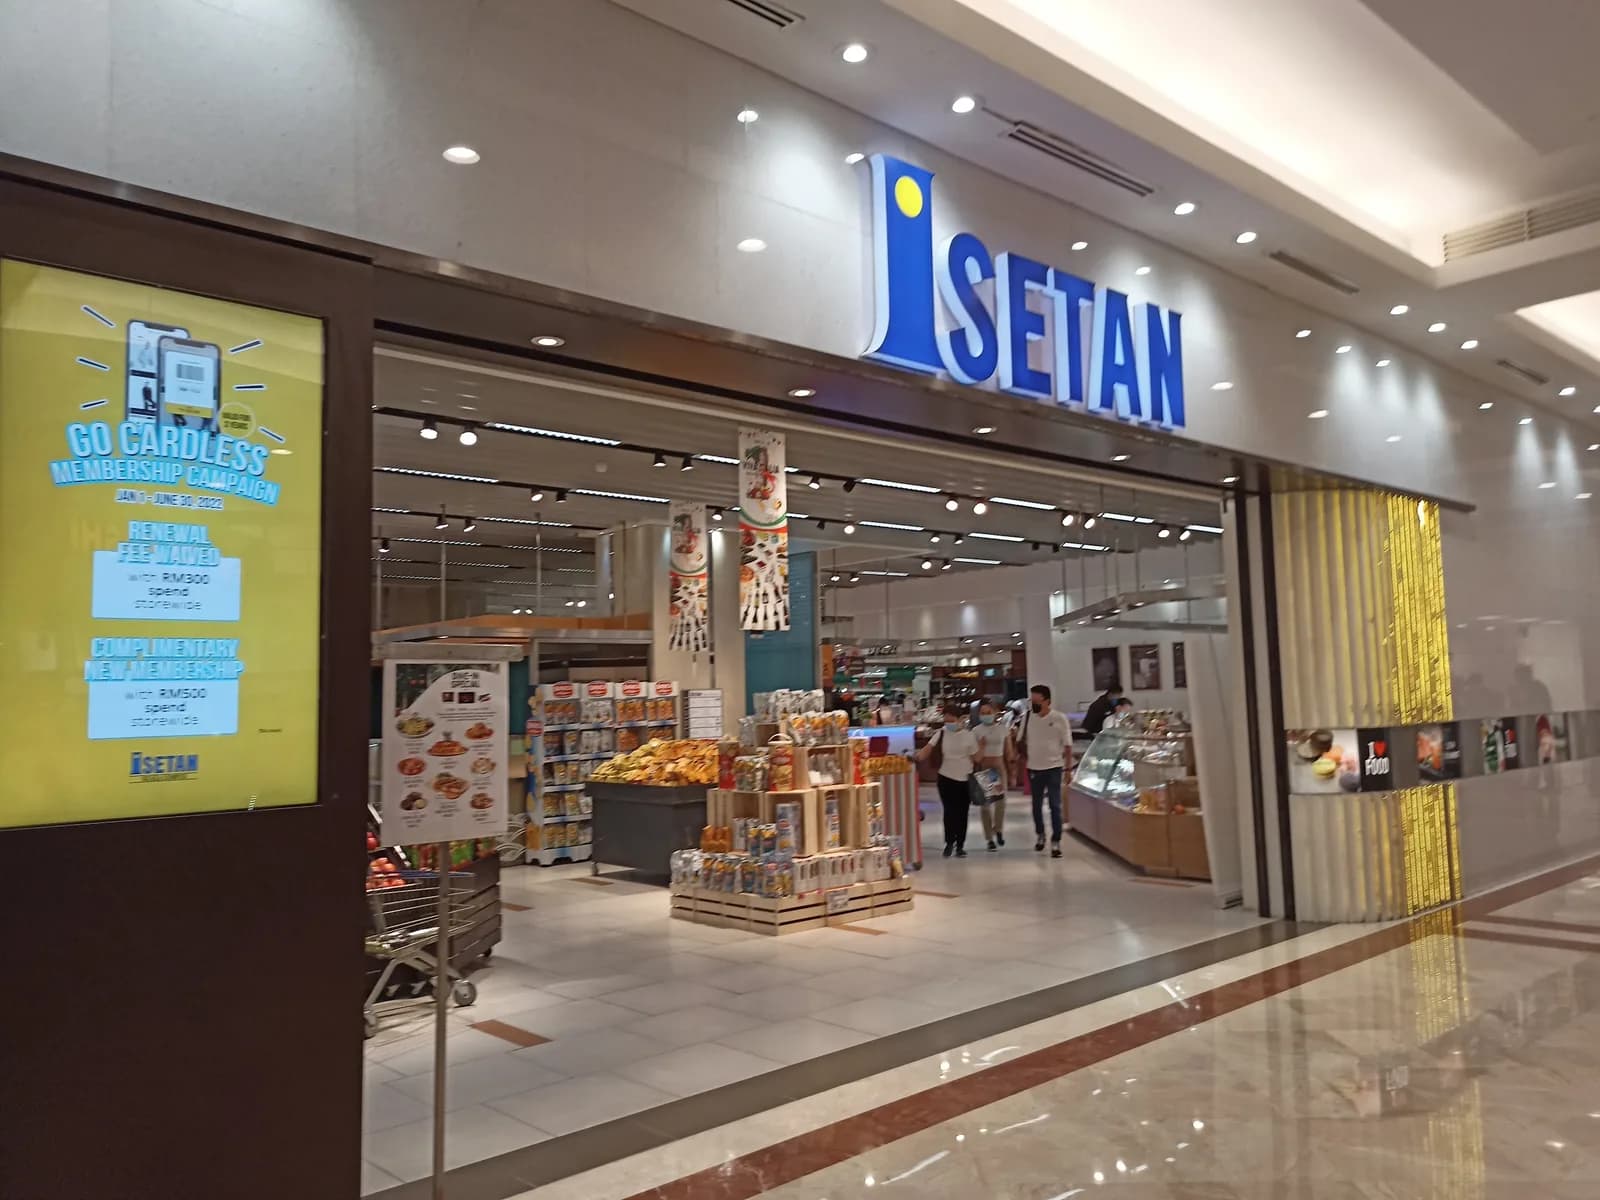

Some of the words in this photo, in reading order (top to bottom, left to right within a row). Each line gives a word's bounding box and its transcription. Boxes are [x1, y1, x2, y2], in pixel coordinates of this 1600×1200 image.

[67, 422, 113, 458] GO
[119, 421, 269, 477] CARDLESS
[51, 459, 184, 486] MEMBERSHIP
[185, 466, 280, 506] CAMPAIGN
[116, 489, 136, 503] JAN
[154, 492, 179, 506] JUNE
[197, 495, 225, 511] 2022
[129, 520, 210, 545] RENEWAL
[117, 541, 151, 564] FEE
[154, 544, 222, 568] WAIVED
[162, 572, 210, 585] RM300
[148, 586, 190, 600] spend
[134, 599, 202, 611] storewide
[91, 637, 240, 660] COMPLIMENTARY
[129, 659, 245, 682] MEMBERSHIP
[159, 687, 208, 700] RM500
[145, 702, 187, 716] spend
[131, 716, 200, 728] storewide
[1367, 741, 1376, 759] I
[1364, 757, 1390, 776] FOOD
